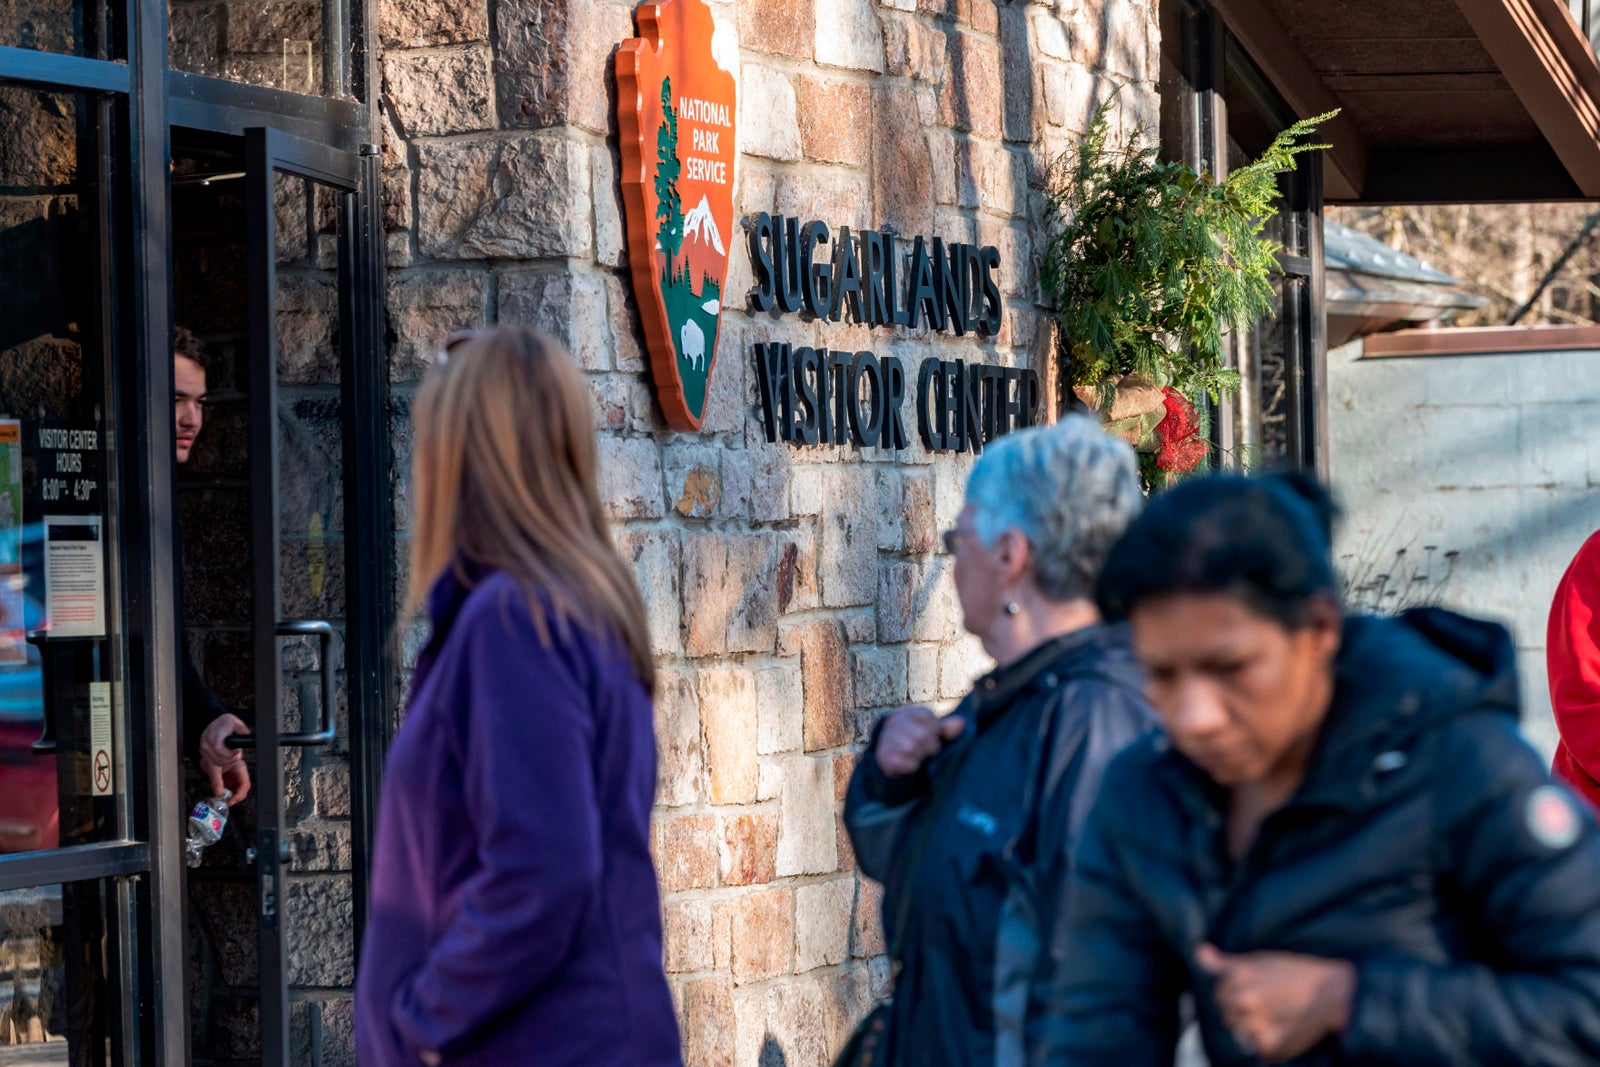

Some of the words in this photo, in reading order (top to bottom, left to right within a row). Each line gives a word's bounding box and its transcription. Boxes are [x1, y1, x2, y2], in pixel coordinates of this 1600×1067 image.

[680, 96, 731, 127] NATIONAL
[693, 128, 719, 154] PARK
[687, 157, 726, 184] SERVICE
[747, 211, 1001, 336] SUGARLANDS
[754, 341, 907, 450] VISITOR
[39, 428, 68, 449] VISITOR
[69, 430, 97, 450] CENTER
[56, 452, 82, 472] HOURS
